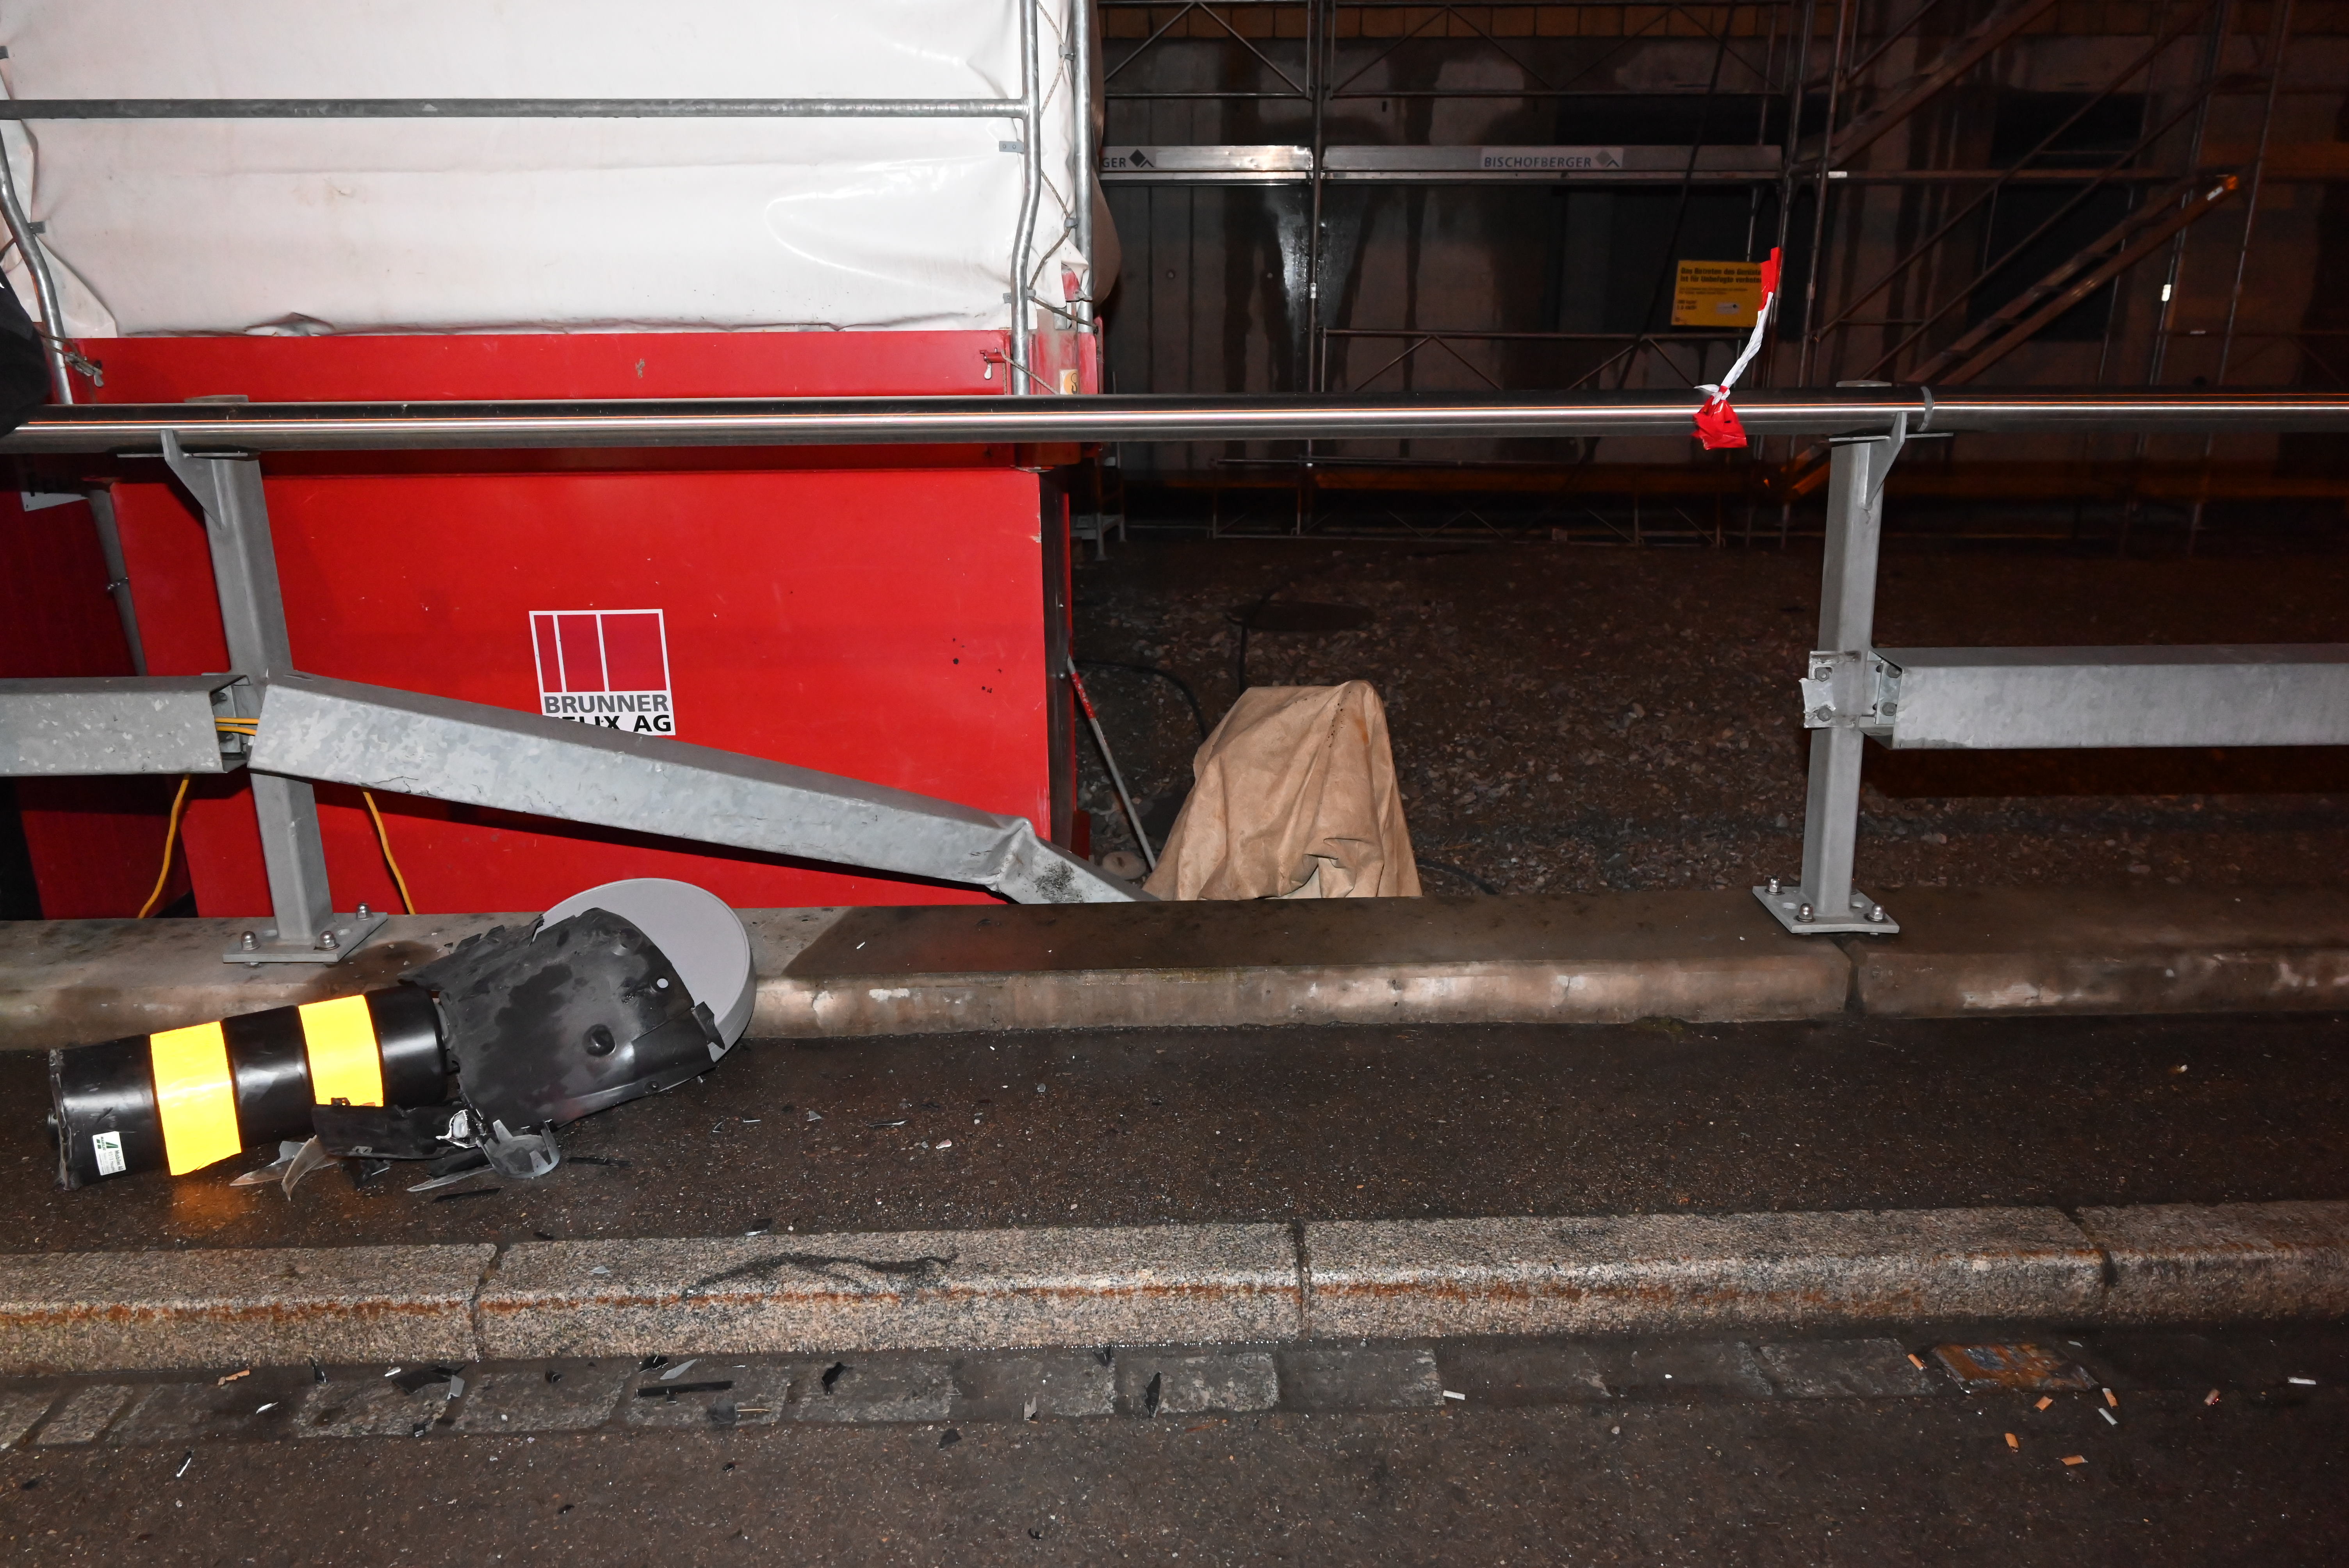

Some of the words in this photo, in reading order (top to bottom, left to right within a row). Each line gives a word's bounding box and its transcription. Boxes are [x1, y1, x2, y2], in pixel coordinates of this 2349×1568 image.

[1484, 157, 1592, 167] BISCHOFBERGER
[1701, 275, 1734, 283] Unbefugte
[544, 694, 669, 713] BRUNNER
[633, 714, 671, 732] AG
